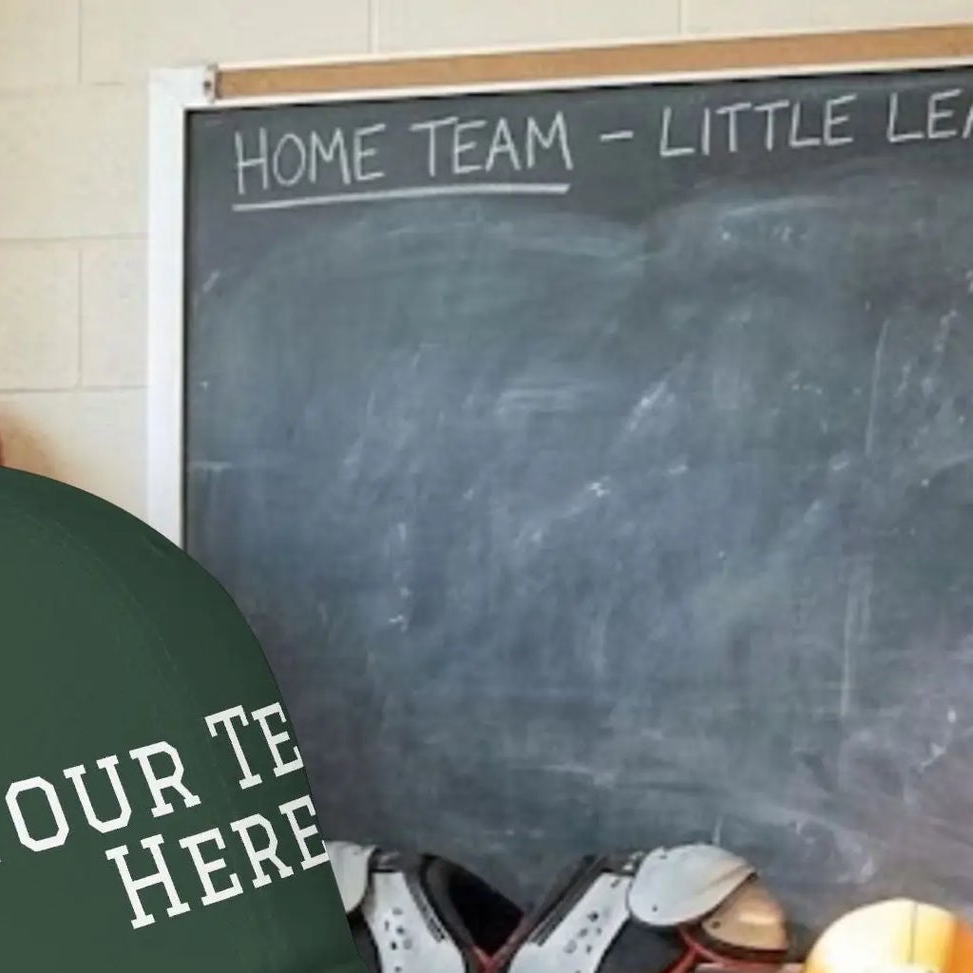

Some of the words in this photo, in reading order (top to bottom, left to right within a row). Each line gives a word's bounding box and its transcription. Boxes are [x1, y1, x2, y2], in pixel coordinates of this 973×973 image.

[235, 124, 385, 193] HOME
[411, 112, 573, 178] TEAM
[658, 95, 856, 157] LITTLE
